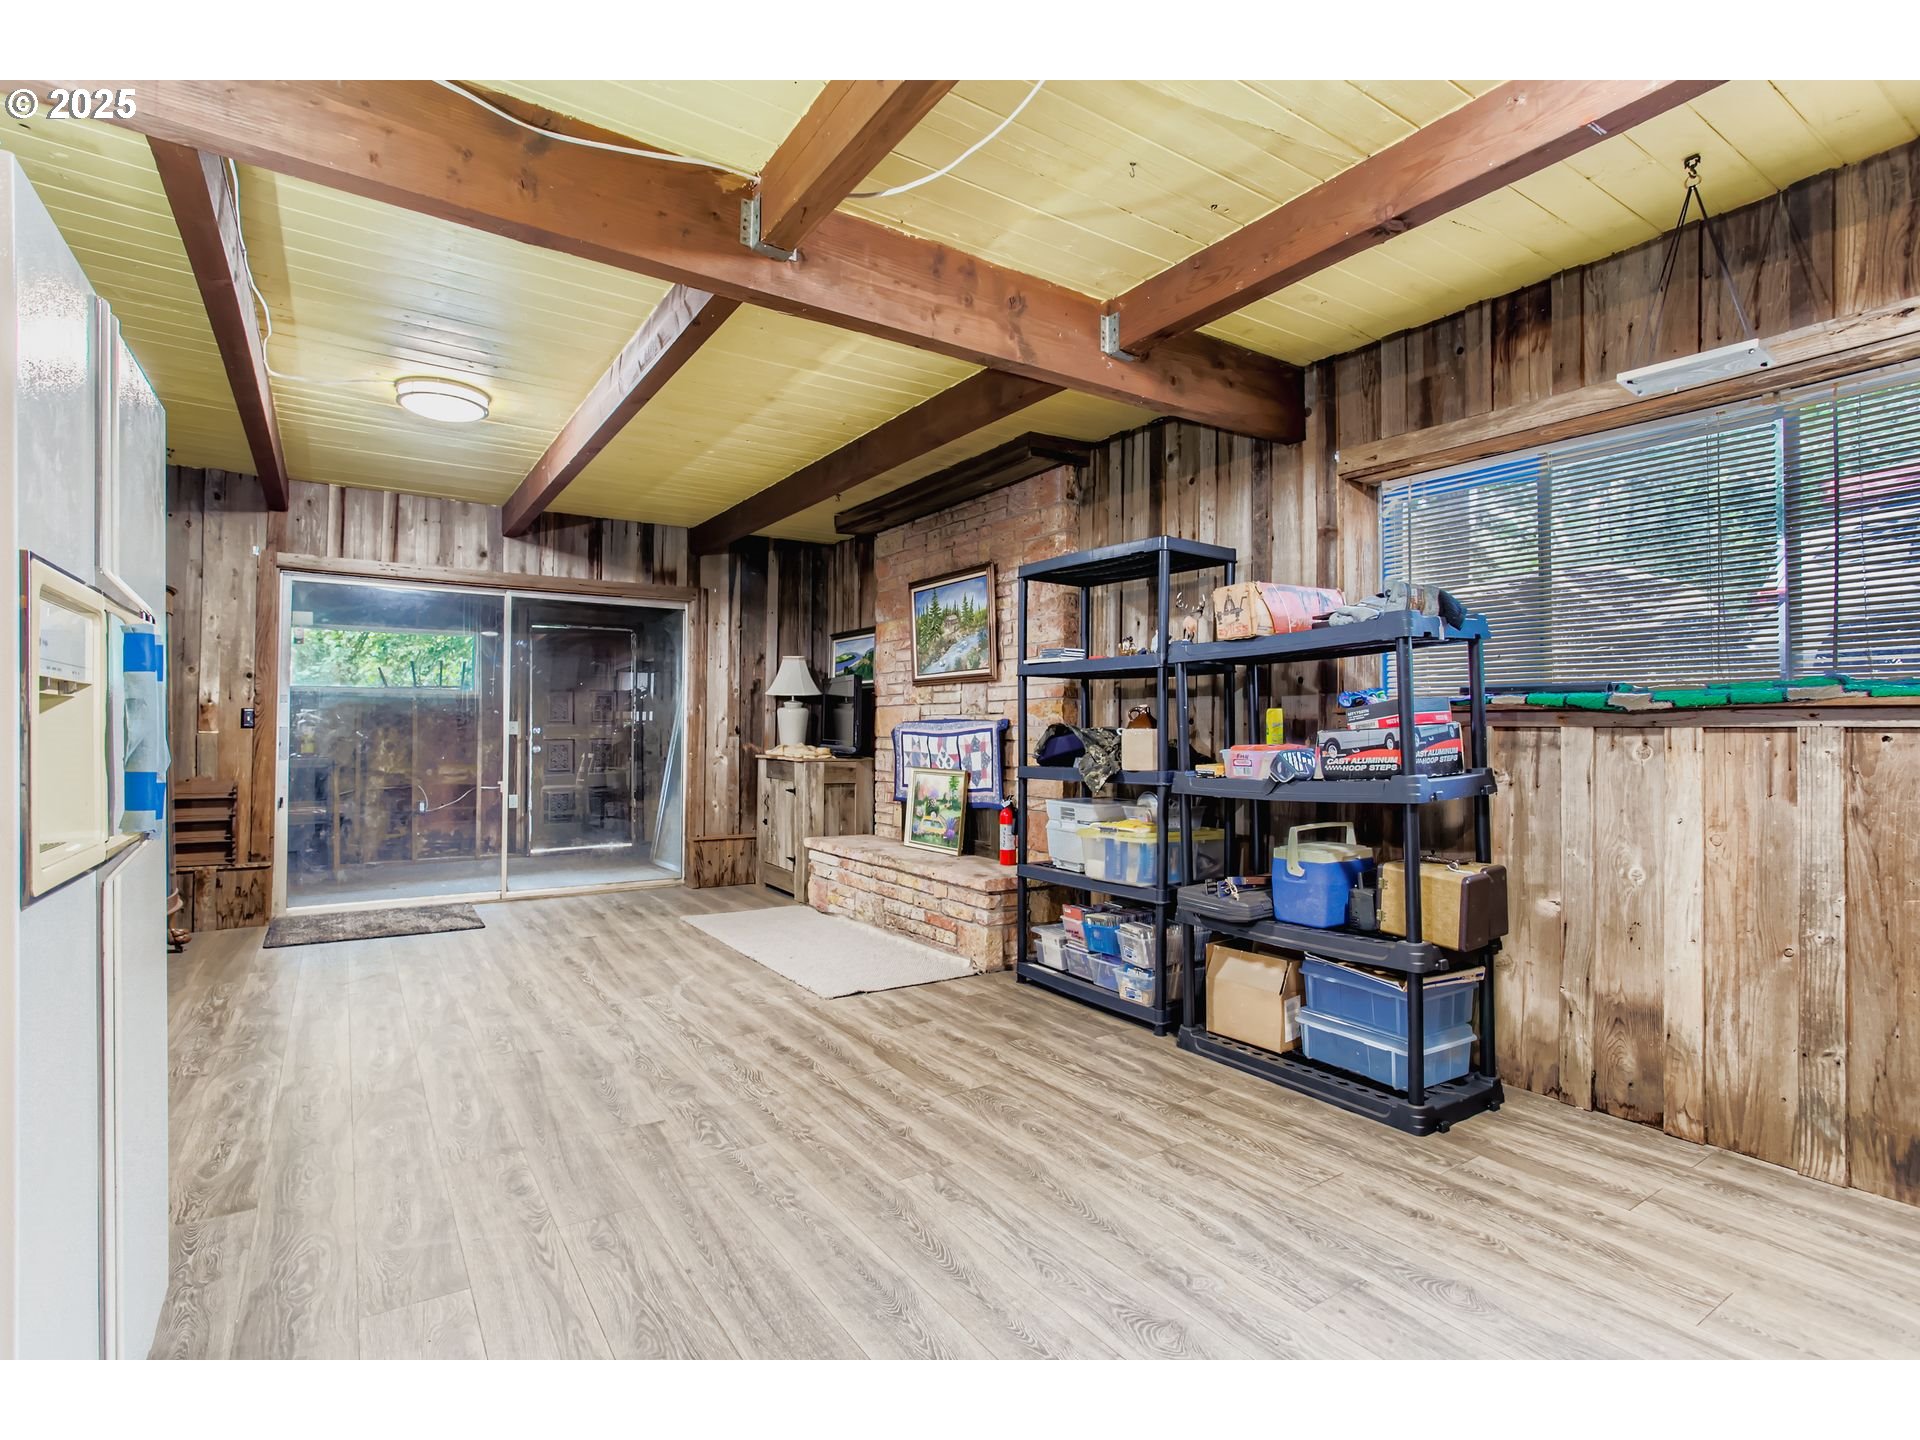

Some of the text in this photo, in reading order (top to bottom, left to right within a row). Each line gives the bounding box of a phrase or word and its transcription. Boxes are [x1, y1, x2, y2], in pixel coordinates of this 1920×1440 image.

[1326, 756, 1399, 765] CAST ALUMINUM
[1422, 754, 1459, 765] HOOP STEPS
[1342, 763, 1398, 772] HOOP STEPS
